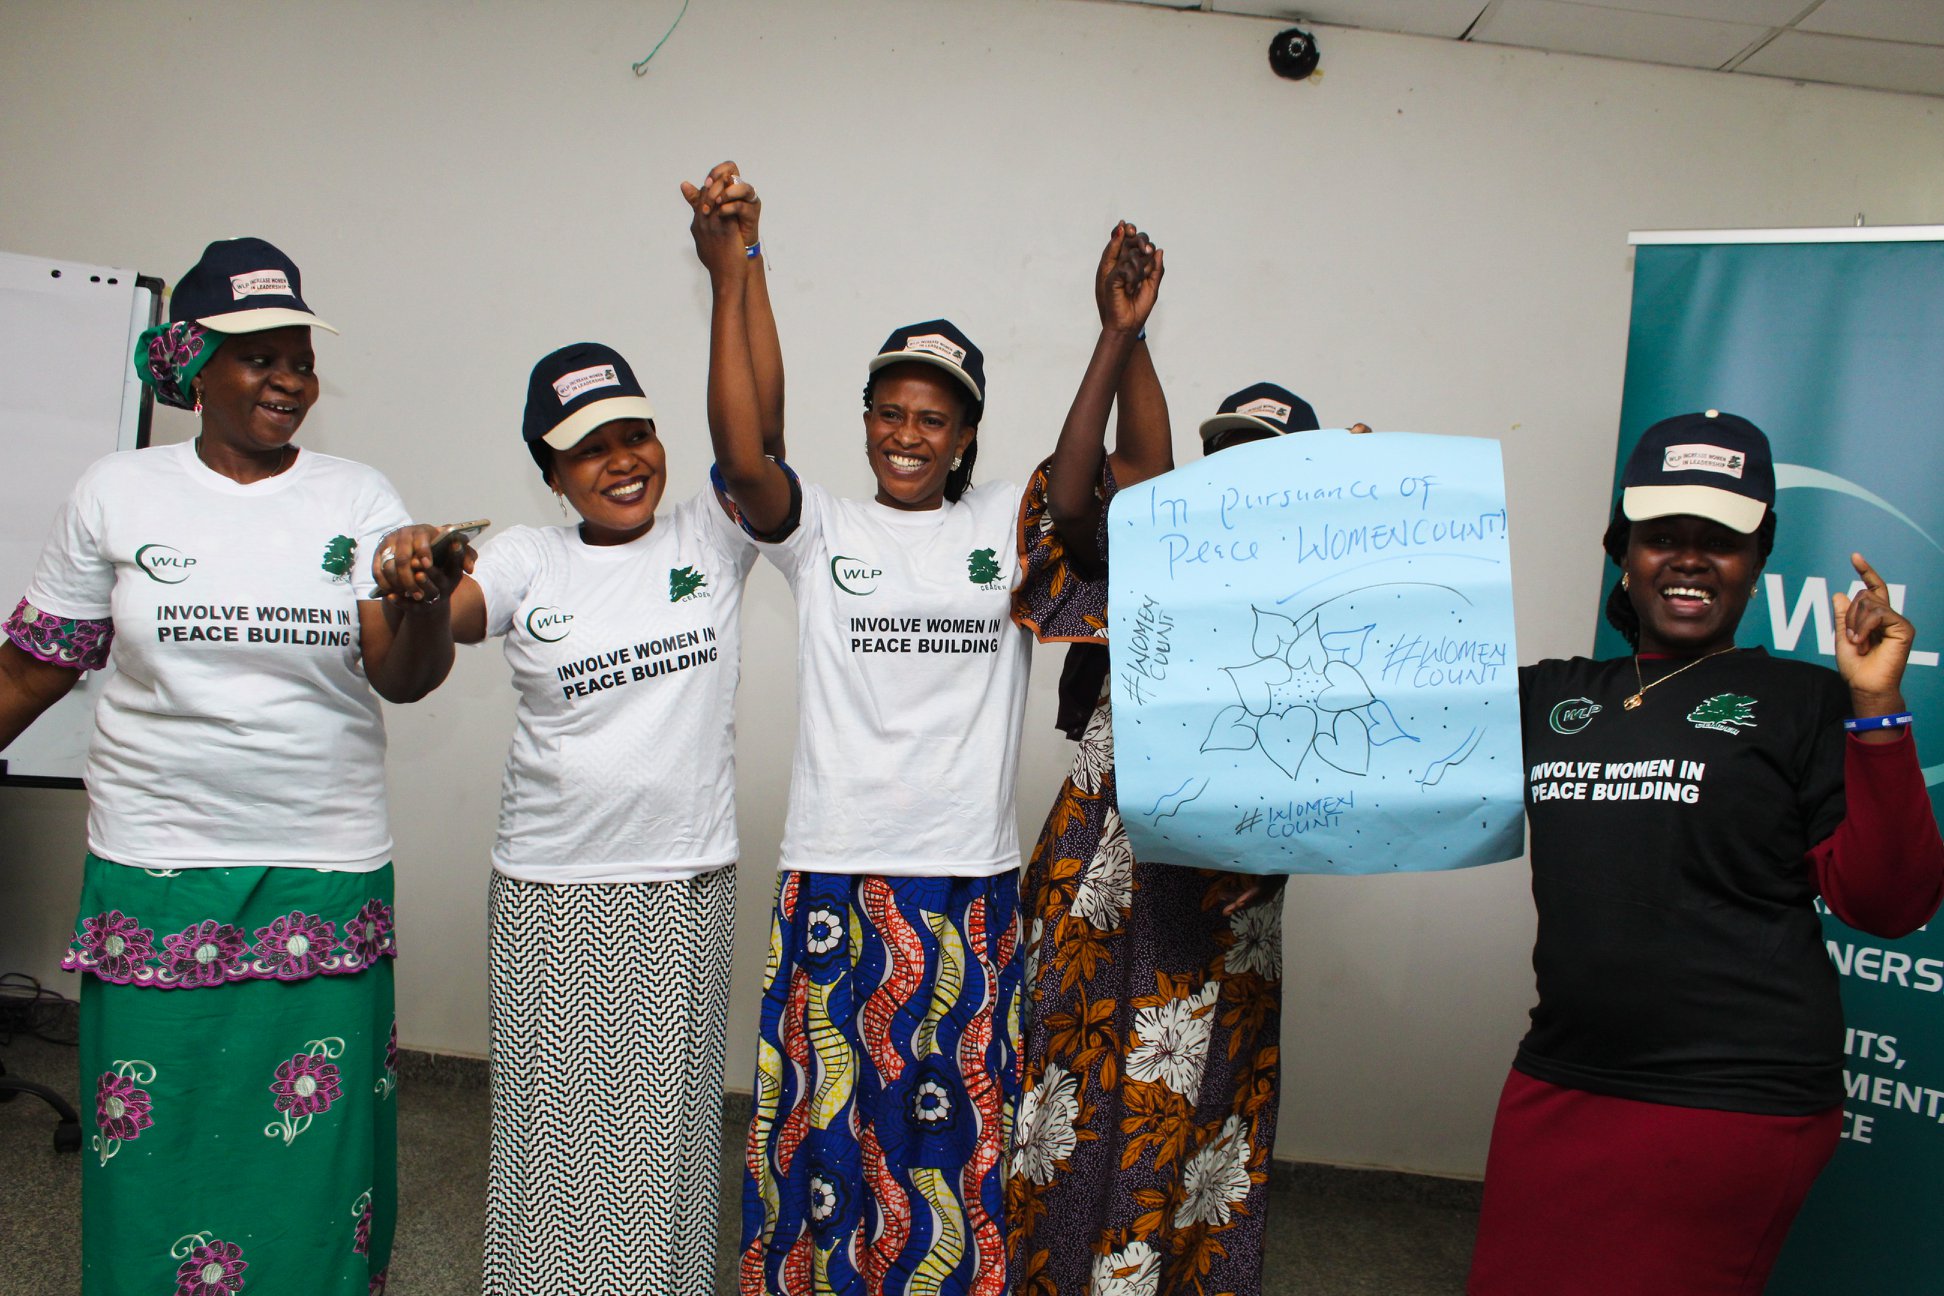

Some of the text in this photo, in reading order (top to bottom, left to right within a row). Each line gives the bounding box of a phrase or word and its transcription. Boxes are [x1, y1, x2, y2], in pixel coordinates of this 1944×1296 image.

[1151, 486, 1188, 528] In
[151, 556, 197, 569] WLP
[1159, 533, 1259, 581] Peace
[842, 569, 883, 579] WLP
[157, 605, 351, 626] INVOLVE WOMEN IN
[537, 614, 574, 629] WLP
[850, 617, 1000, 634] INVOLVE WOMEN IN
[157, 626, 350, 647] PEACE BUILDING
[851, 638, 998, 654] PEACE BUILDING
[557, 626, 717, 681] INVOLVE WOMEN IN
[562, 646, 718, 700] PEACE BUILDING
[1563, 704, 1603, 722] WLP
[1530, 759, 1705, 782] INVOLVE WOMEN IN
[1531, 781, 1700, 804] PEACE BUILDING
